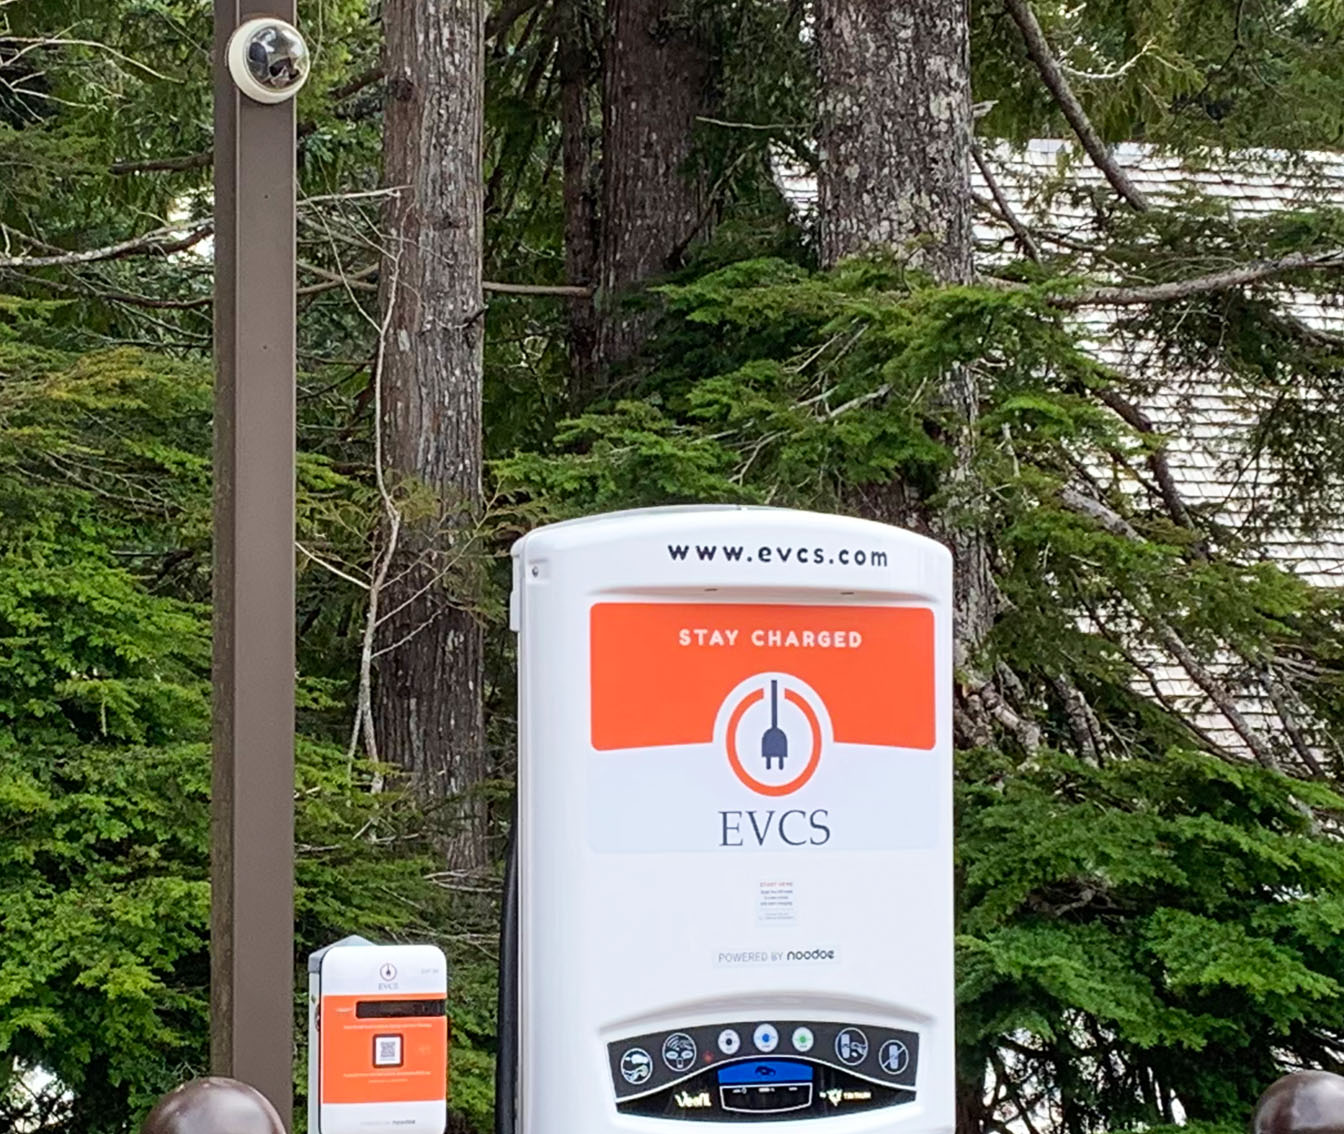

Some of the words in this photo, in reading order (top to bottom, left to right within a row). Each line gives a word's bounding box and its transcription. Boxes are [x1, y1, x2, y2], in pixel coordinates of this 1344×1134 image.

[667, 544, 888, 567] www.evcs.com
[678, 628, 738, 647] STAY
[751, 629, 863, 648] CHARGED
[718, 808, 831, 847] EVCS
[718, 951, 768, 963] POWERED
[770, 951, 784, 962] BY
[786, 949, 835, 961] noodoe
